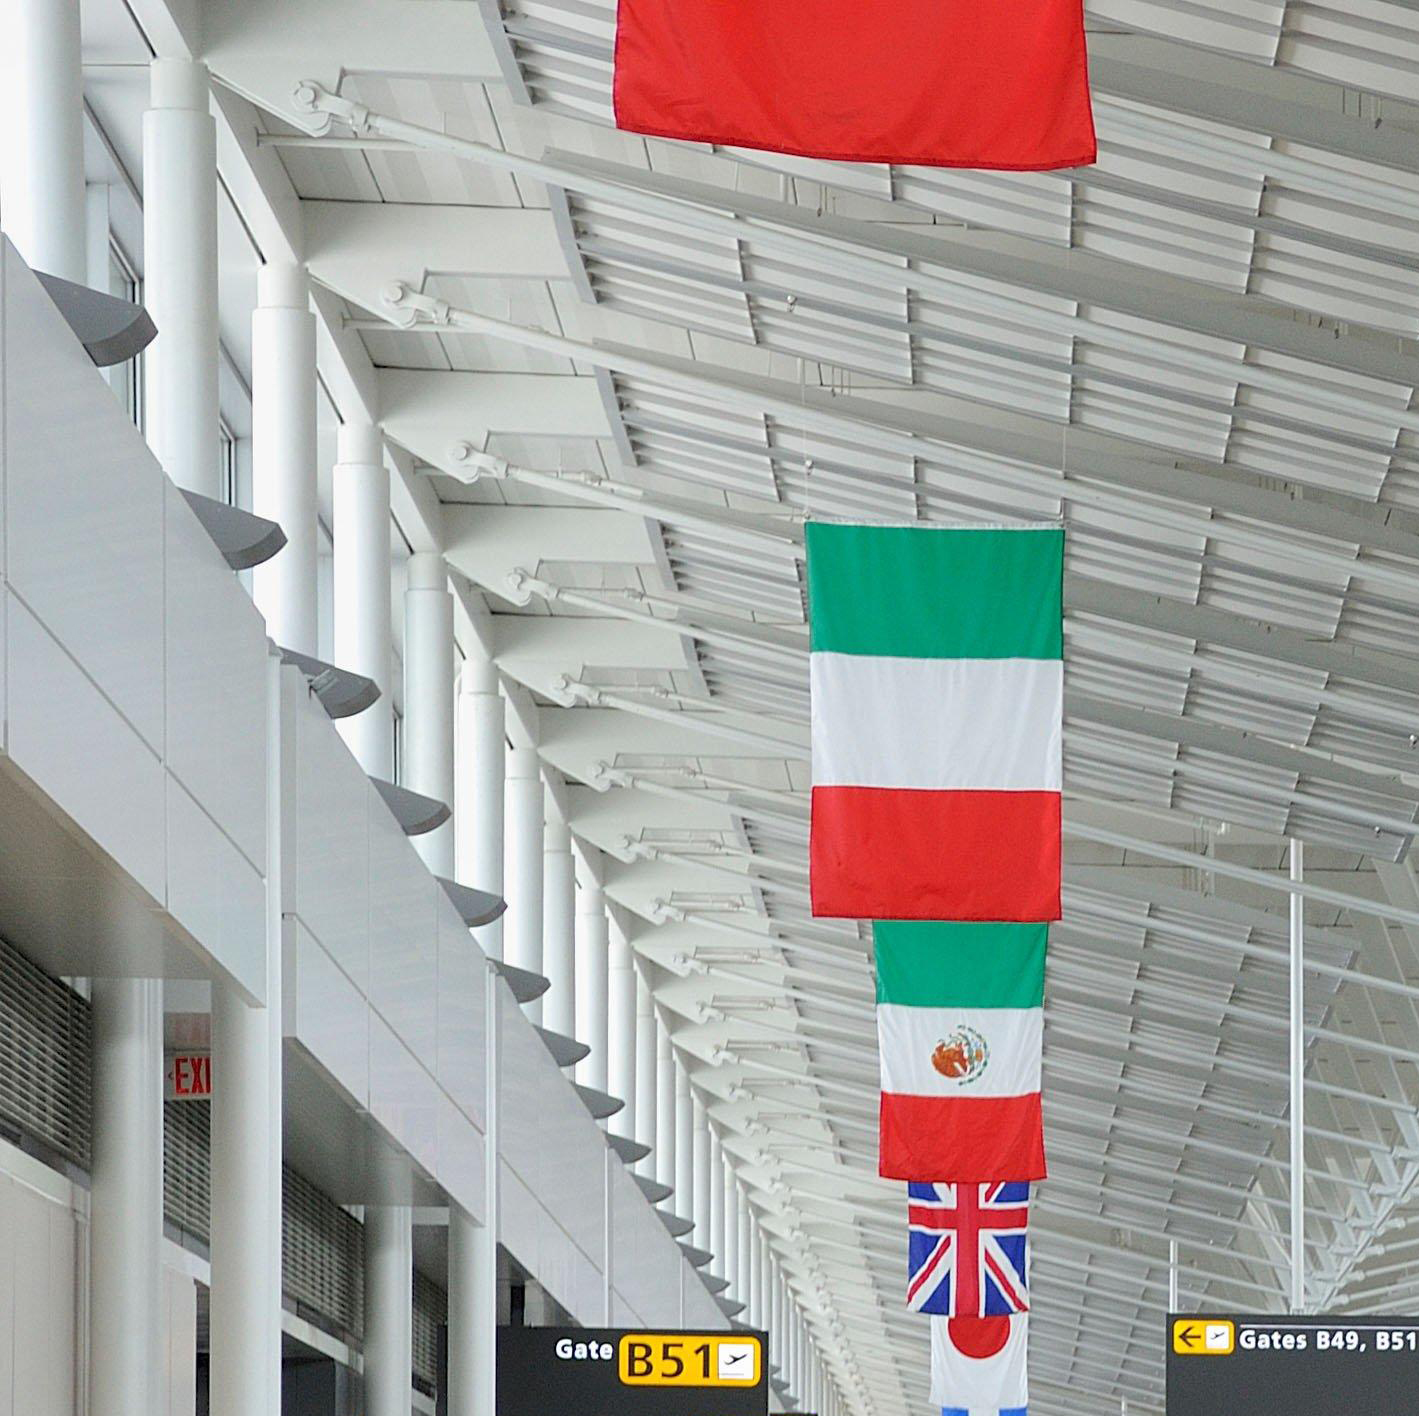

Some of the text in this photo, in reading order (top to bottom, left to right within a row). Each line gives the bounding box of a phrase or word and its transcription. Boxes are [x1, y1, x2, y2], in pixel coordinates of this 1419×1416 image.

[175, 1056, 211, 1095] EXI
[555, 1338, 711, 1379] Gate B51
[1239, 1329, 1418, 1353] Gates B49, B51
